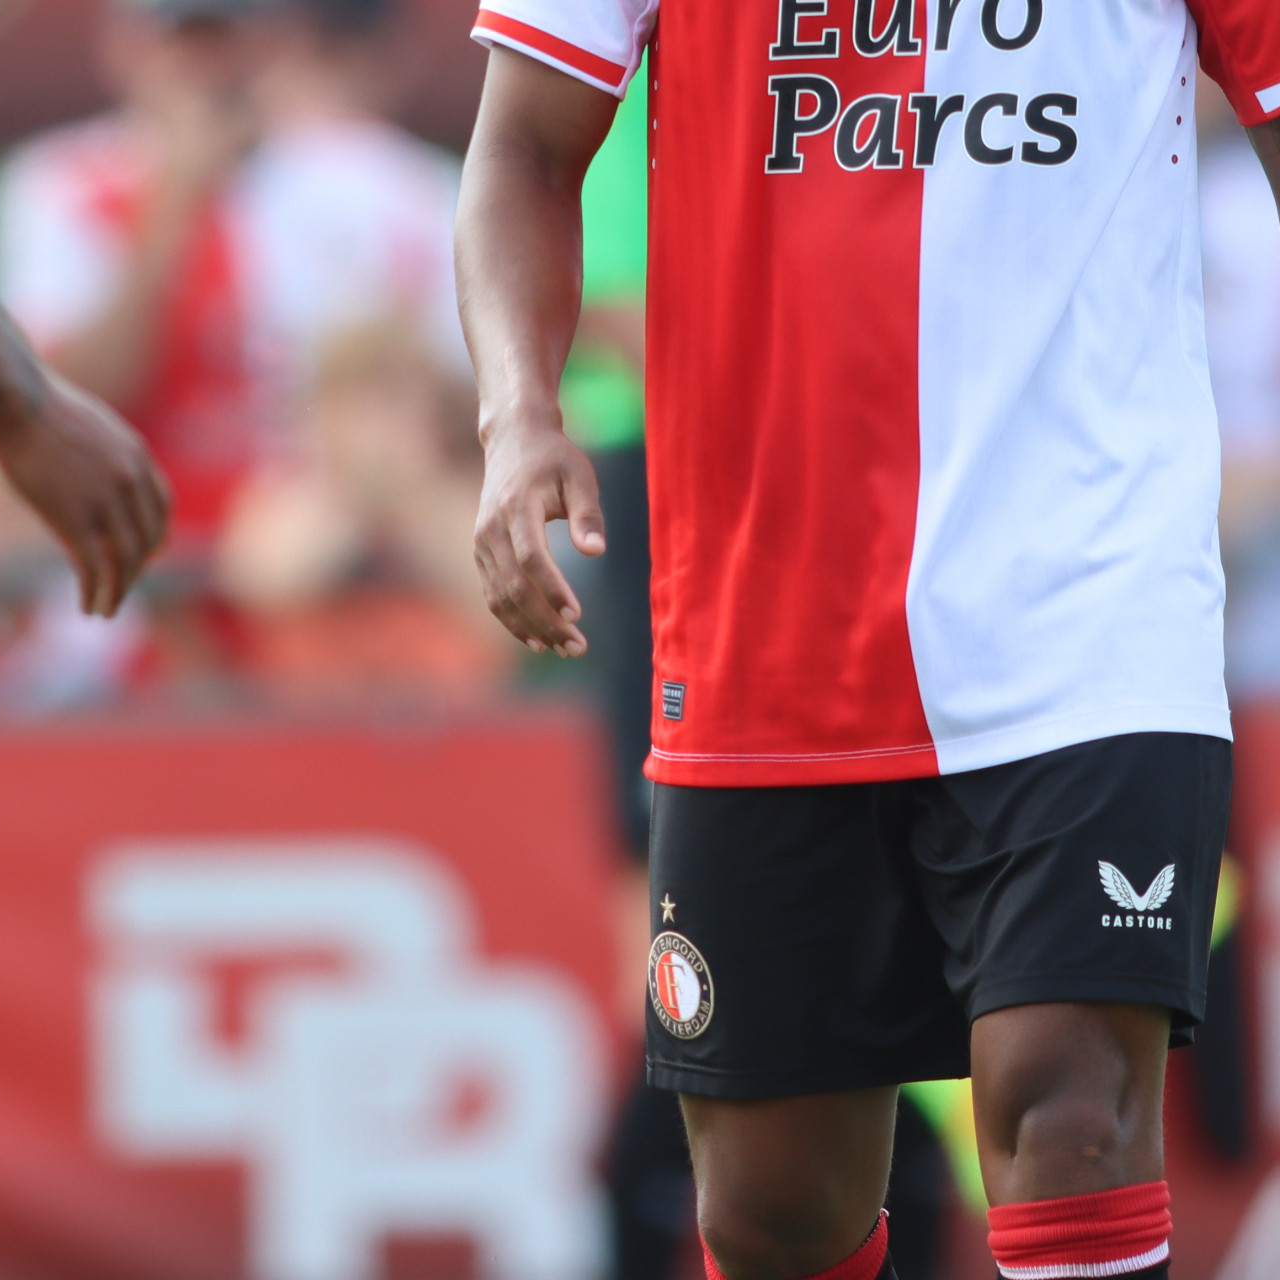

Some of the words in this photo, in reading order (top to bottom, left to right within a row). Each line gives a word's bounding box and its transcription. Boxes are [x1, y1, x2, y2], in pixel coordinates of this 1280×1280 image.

[764, 73, 1079, 174] Parcs
[1101, 914, 1172, 930] CASTORE
[650, 936, 704, 973] FEYENOORD
[660, 962, 686, 1010] F
[653, 997, 710, 1036] ROTTERDAM
